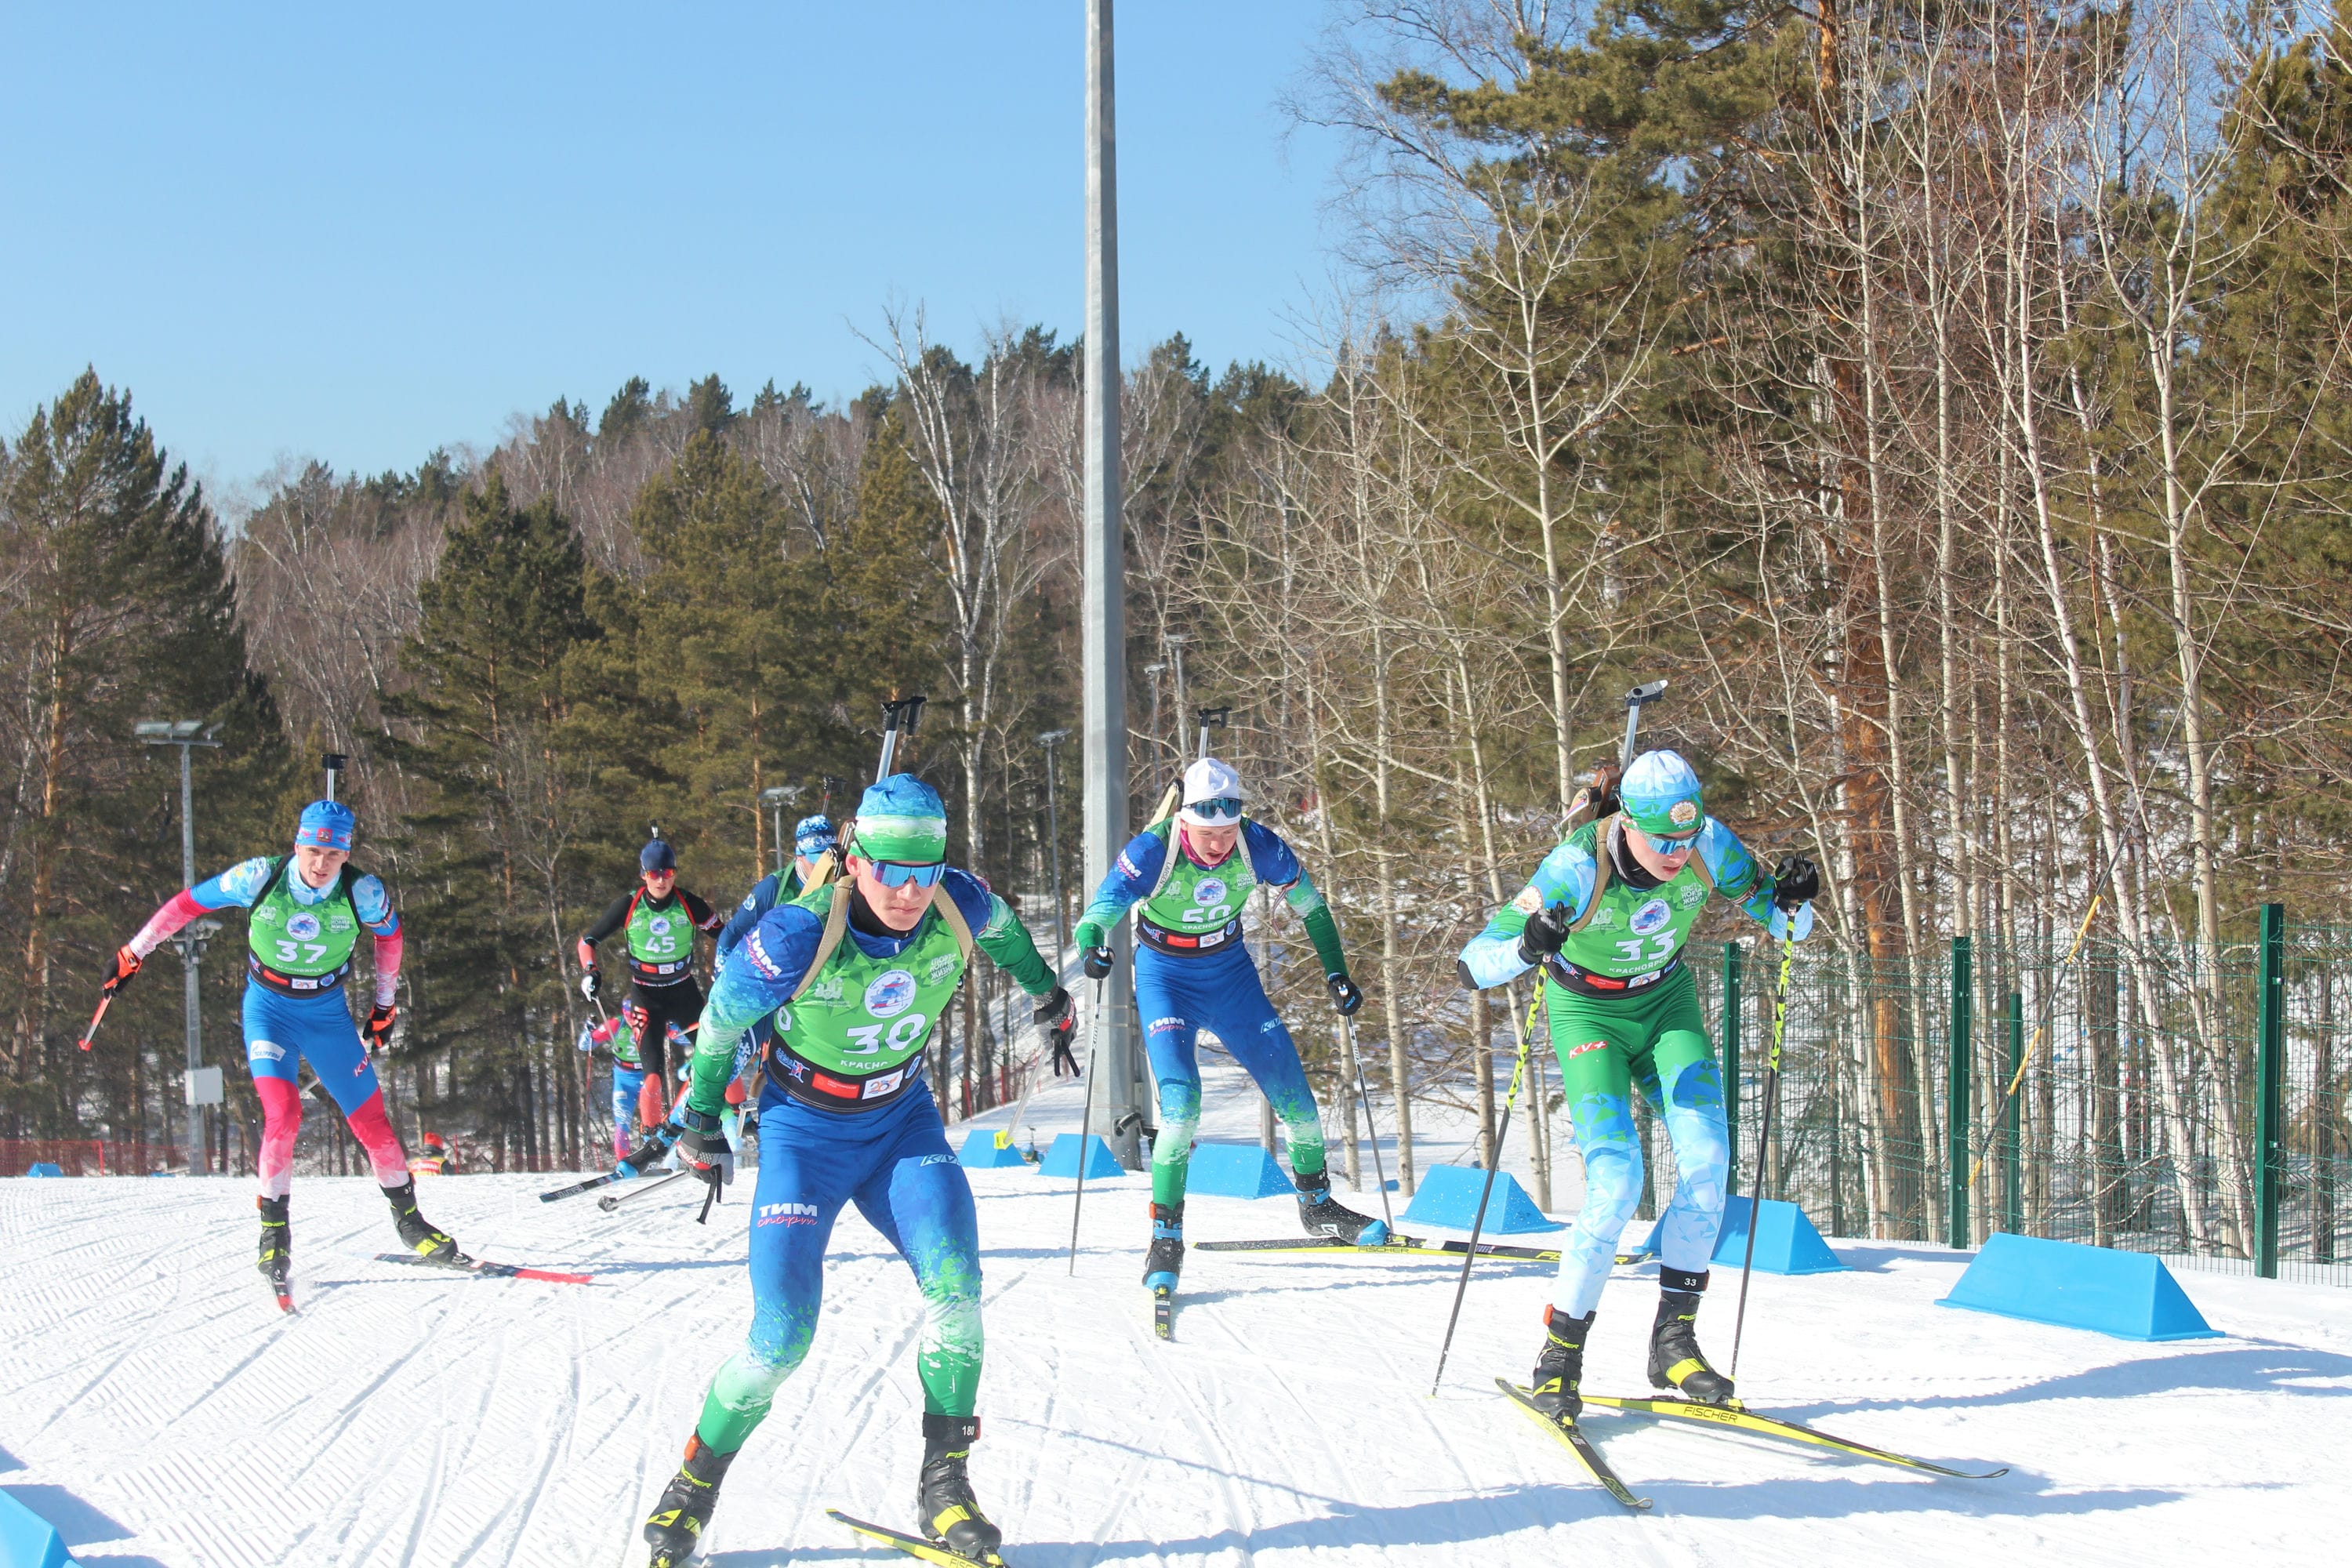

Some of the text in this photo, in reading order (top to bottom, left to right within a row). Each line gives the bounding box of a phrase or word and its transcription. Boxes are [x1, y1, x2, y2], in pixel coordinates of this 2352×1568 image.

[1160, 862, 1173, 885] LARSEN
[1181, 904, 1232, 924] 50
[276, 939, 328, 964] 37
[645, 936, 676, 953] 45
[1611, 928, 1678, 962] 33
[1609, 956, 1670, 975] КРАСНОЯРСК
[1148, 1017, 1185, 1032] ТИМ
[843, 1013, 926, 1055] 30
[1569, 1040, 1606, 1059] KV+
[759, 1203, 818, 1218] ТИМ
[1358, 1246, 1410, 1254] FISCHER
[1684, 1278, 1697, 1287] 33
[1682, 1406, 1738, 1424] FISCHER
[962, 1425, 975, 1436] 180
